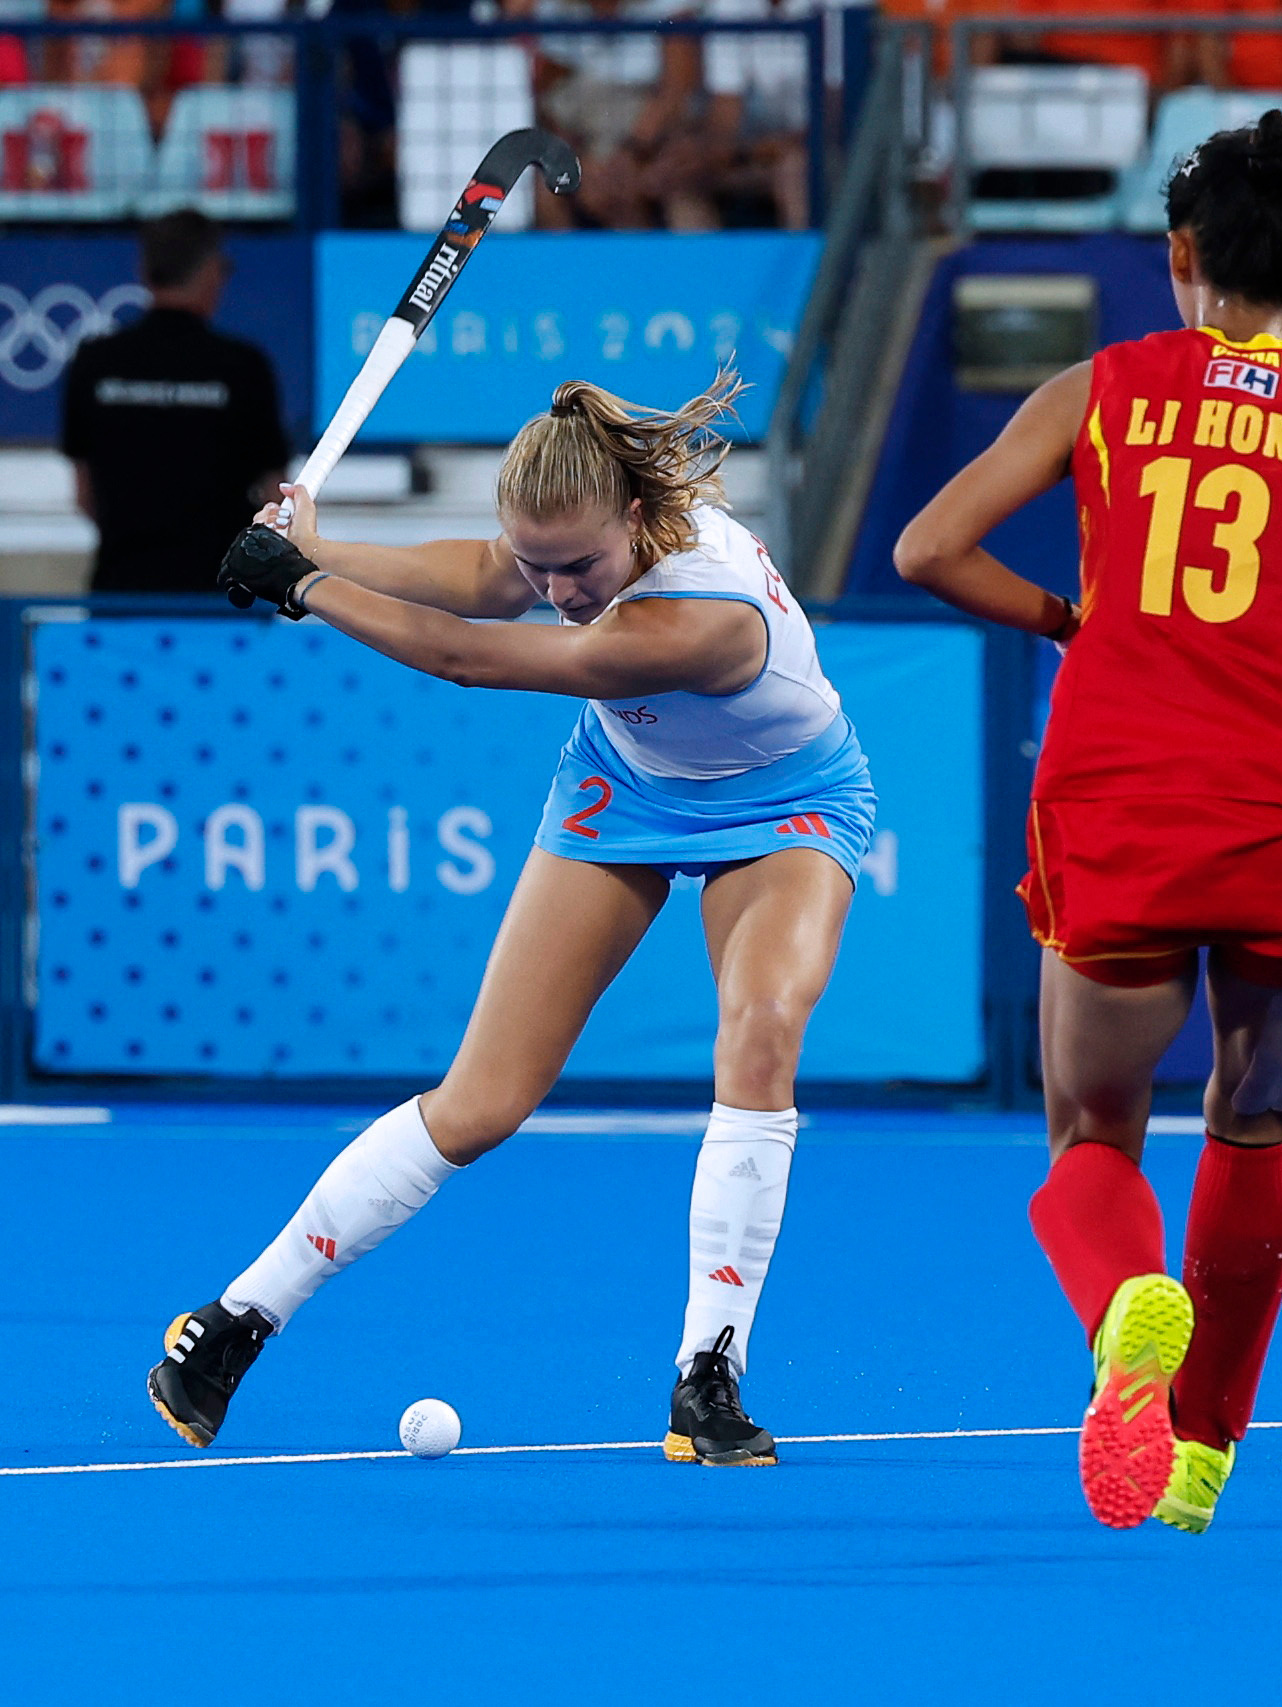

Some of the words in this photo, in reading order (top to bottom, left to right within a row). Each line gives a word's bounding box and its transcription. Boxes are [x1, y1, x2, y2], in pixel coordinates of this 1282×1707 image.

[408, 242, 459, 313] ritual
[1125, 397, 1182, 445] LI
[1138, 456, 1271, 624] 13
[562, 776, 613, 839] 2
